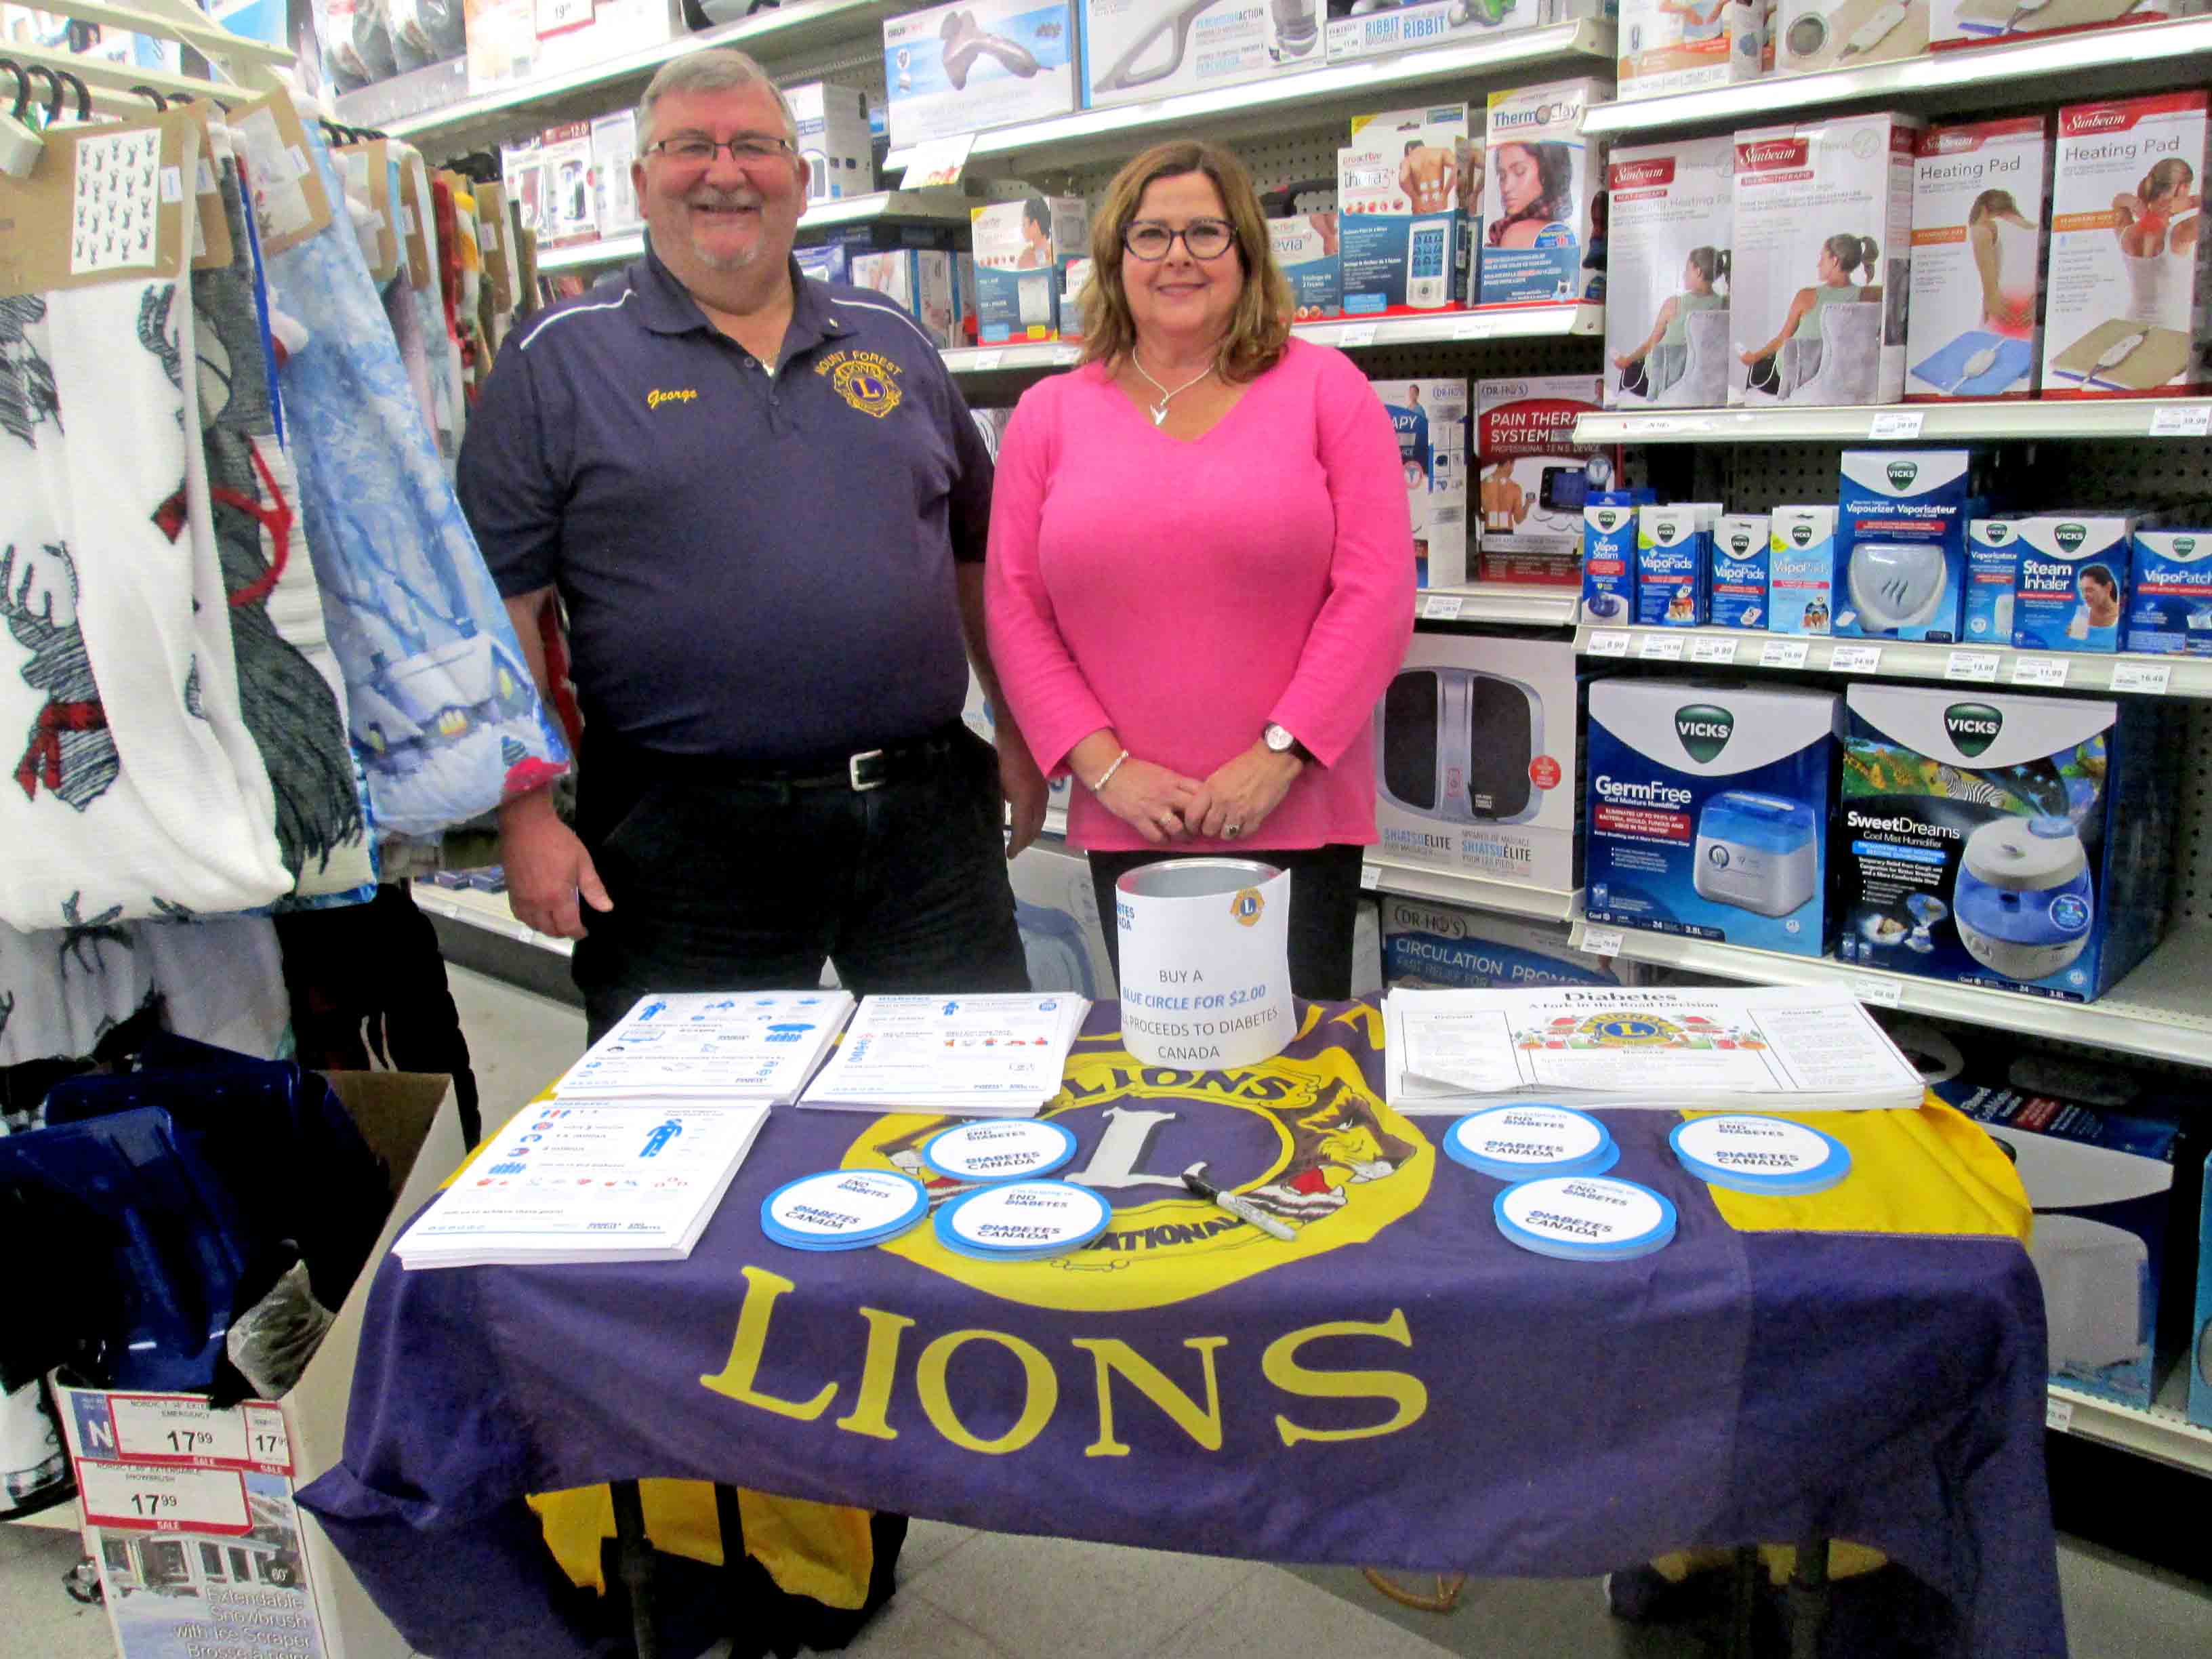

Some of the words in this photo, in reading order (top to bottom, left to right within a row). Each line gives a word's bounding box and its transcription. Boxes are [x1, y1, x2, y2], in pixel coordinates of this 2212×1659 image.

[1366, 16, 1399, 34] RIBBIT
[1404, 16, 1446, 39] RIBBIT
[2066, 112, 2126, 131] Sunbeam
[1922, 135, 1973, 150] Sunbeam
[2065, 141, 2137, 161] Heating
[2144, 136, 2179, 153] Pad
[1740, 148, 1796, 165] Sunbeam
[1614, 167, 1665, 184] Sunbeam
[1920, 161, 1984, 180] Heating
[1990, 156, 2021, 173] Pad
[815, 350, 846, 375] MOUNT
[852, 350, 904, 375] FOREST
[647, 388, 698, 408] George
[1491, 412, 1531, 427] PAIN
[1491, 429, 1549, 444] SYSTEM
[1888, 470, 1915, 478] VICKS
[1846, 504, 1896, 514] Vapourizer
[1897, 504, 1957, 514] Vaporisateur
[2055, 531, 2084, 541] VICKS
[1641, 556, 1692, 571] VapoPads
[2023, 559, 2072, 576] Steam
[1714, 565, 1765, 581] VapoPads
[2024, 575, 2070, 591] Inhaler
[1678, 721, 1729, 739] VICKS
[1947, 718, 1998, 735] VICKS
[1595, 775, 1692, 804] GermFree
[1847, 811, 1961, 840] SweetDreams
[1864, 831, 1883, 840] Cool
[1884, 833, 1901, 842] Mist
[1902, 836, 1942, 848] Humidifier
[1244, 899, 1253, 914] L
[1395, 938, 1503, 977] CIRCULATION
[1159, 970, 1188, 983] BUY
[1193, 970, 1204, 983] A
[1145, 995, 1189, 1010] CIRCLE
[1194, 995, 1225, 1010] FOR
[1230, 985, 1266, 1007] $2.00
[1563, 991, 1677, 1002] Diabetes
[1129, 1014, 1189, 1037] PROCEEDS
[1193, 1023, 1214, 1036] TO
[1219, 1006, 1278, 1035] DIABETES
[1617, 1023, 1646, 1036] L
[1158, 1046, 1221, 1059] CANADA
[1061, 1068, 1297, 1099] LIONS
[1502, 1120, 1565, 1128] DIABETES
[1717, 1128, 1784, 1136] DIABETES
[966, 1131, 1026, 1141] DIABETES
[1064, 1106, 1208, 1189] L
[1484, 1147, 1554, 1158] CANADA
[1486, 1140, 1564, 1153] DIABETES
[965, 1151, 1040, 1164] DIABETES
[967, 1158, 1036, 1170] CANADA
[1715, 1151, 1799, 1161] DIABETES
[1718, 1158, 1794, 1167] CANADA
[836, 1183, 890, 1198] DIABETES
[844, 1179, 869, 1187] END
[1567, 1184, 1597, 1193] END
[1004, 1200, 1069, 1208] DIABETES
[1561, 1189, 1627, 1206] DIABETES
[785, 1210, 844, 1230] CANADA
[794, 1204, 861, 1225] DIABETES
[1529, 1210, 1613, 1233] DIABETES
[979, 1224, 1062, 1235] DIABETES
[1525, 1216, 1598, 1238] CANADA
[977, 1231, 1050, 1242] CANADA
[699, 1265, 1429, 1458] LIONS
[87, 1419, 114, 1448] N
[157, 1521, 179, 1530] SALE
[206, 1587, 304, 1610] Extendable
[243, 1627, 311, 1649] Scraper
